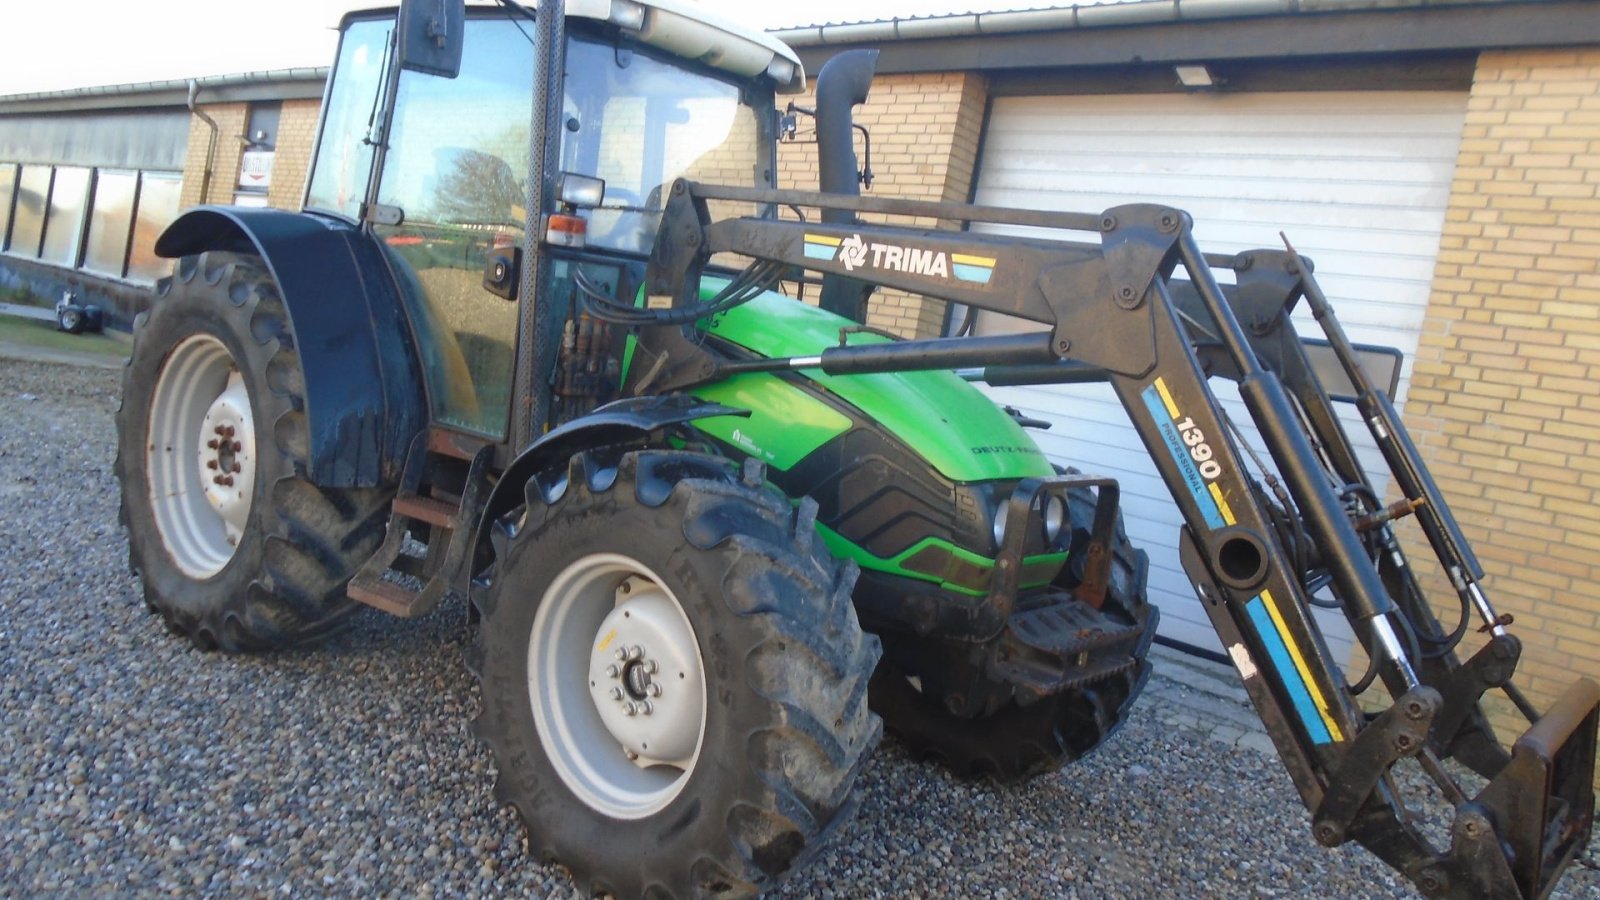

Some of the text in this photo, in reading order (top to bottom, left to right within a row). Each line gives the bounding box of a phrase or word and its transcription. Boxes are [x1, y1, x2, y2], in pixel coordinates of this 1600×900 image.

[871, 243, 948, 278] TRIMA
[1162, 422, 1203, 493] PROFESSIONAL
[1178, 416, 1221, 479] 1390
